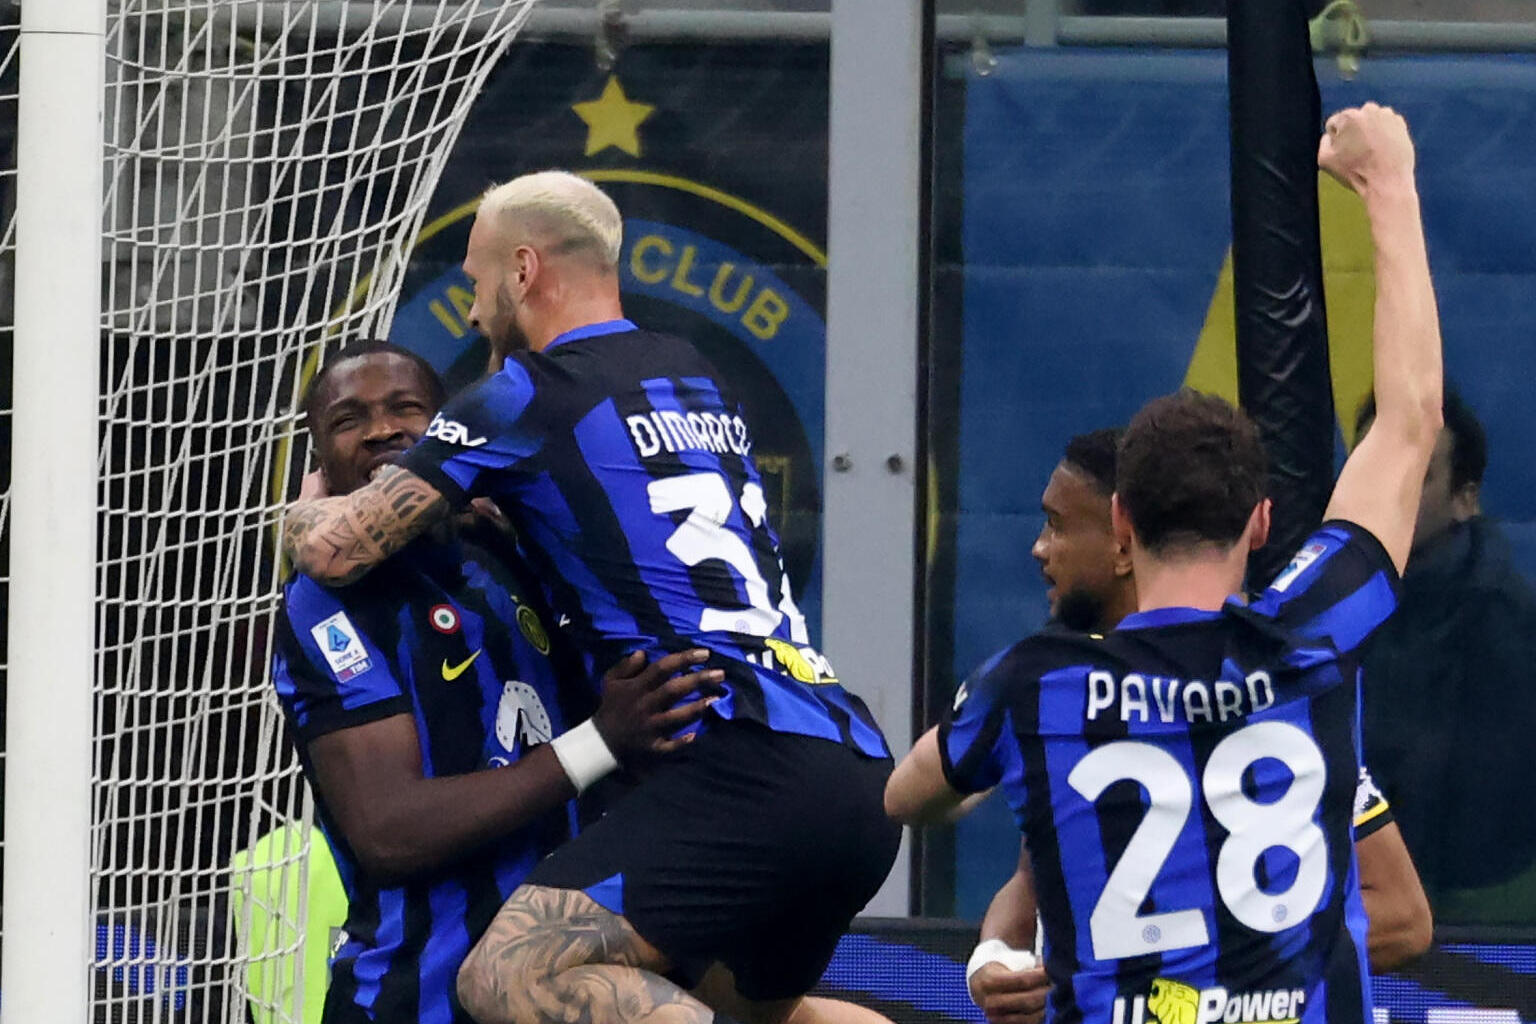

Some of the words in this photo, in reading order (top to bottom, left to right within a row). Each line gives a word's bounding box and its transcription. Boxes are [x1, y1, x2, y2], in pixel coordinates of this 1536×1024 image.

[630, 235, 790, 340] CLUB
[1087, 671, 1275, 723] PAVARD
[1067, 721, 1328, 961] 28
